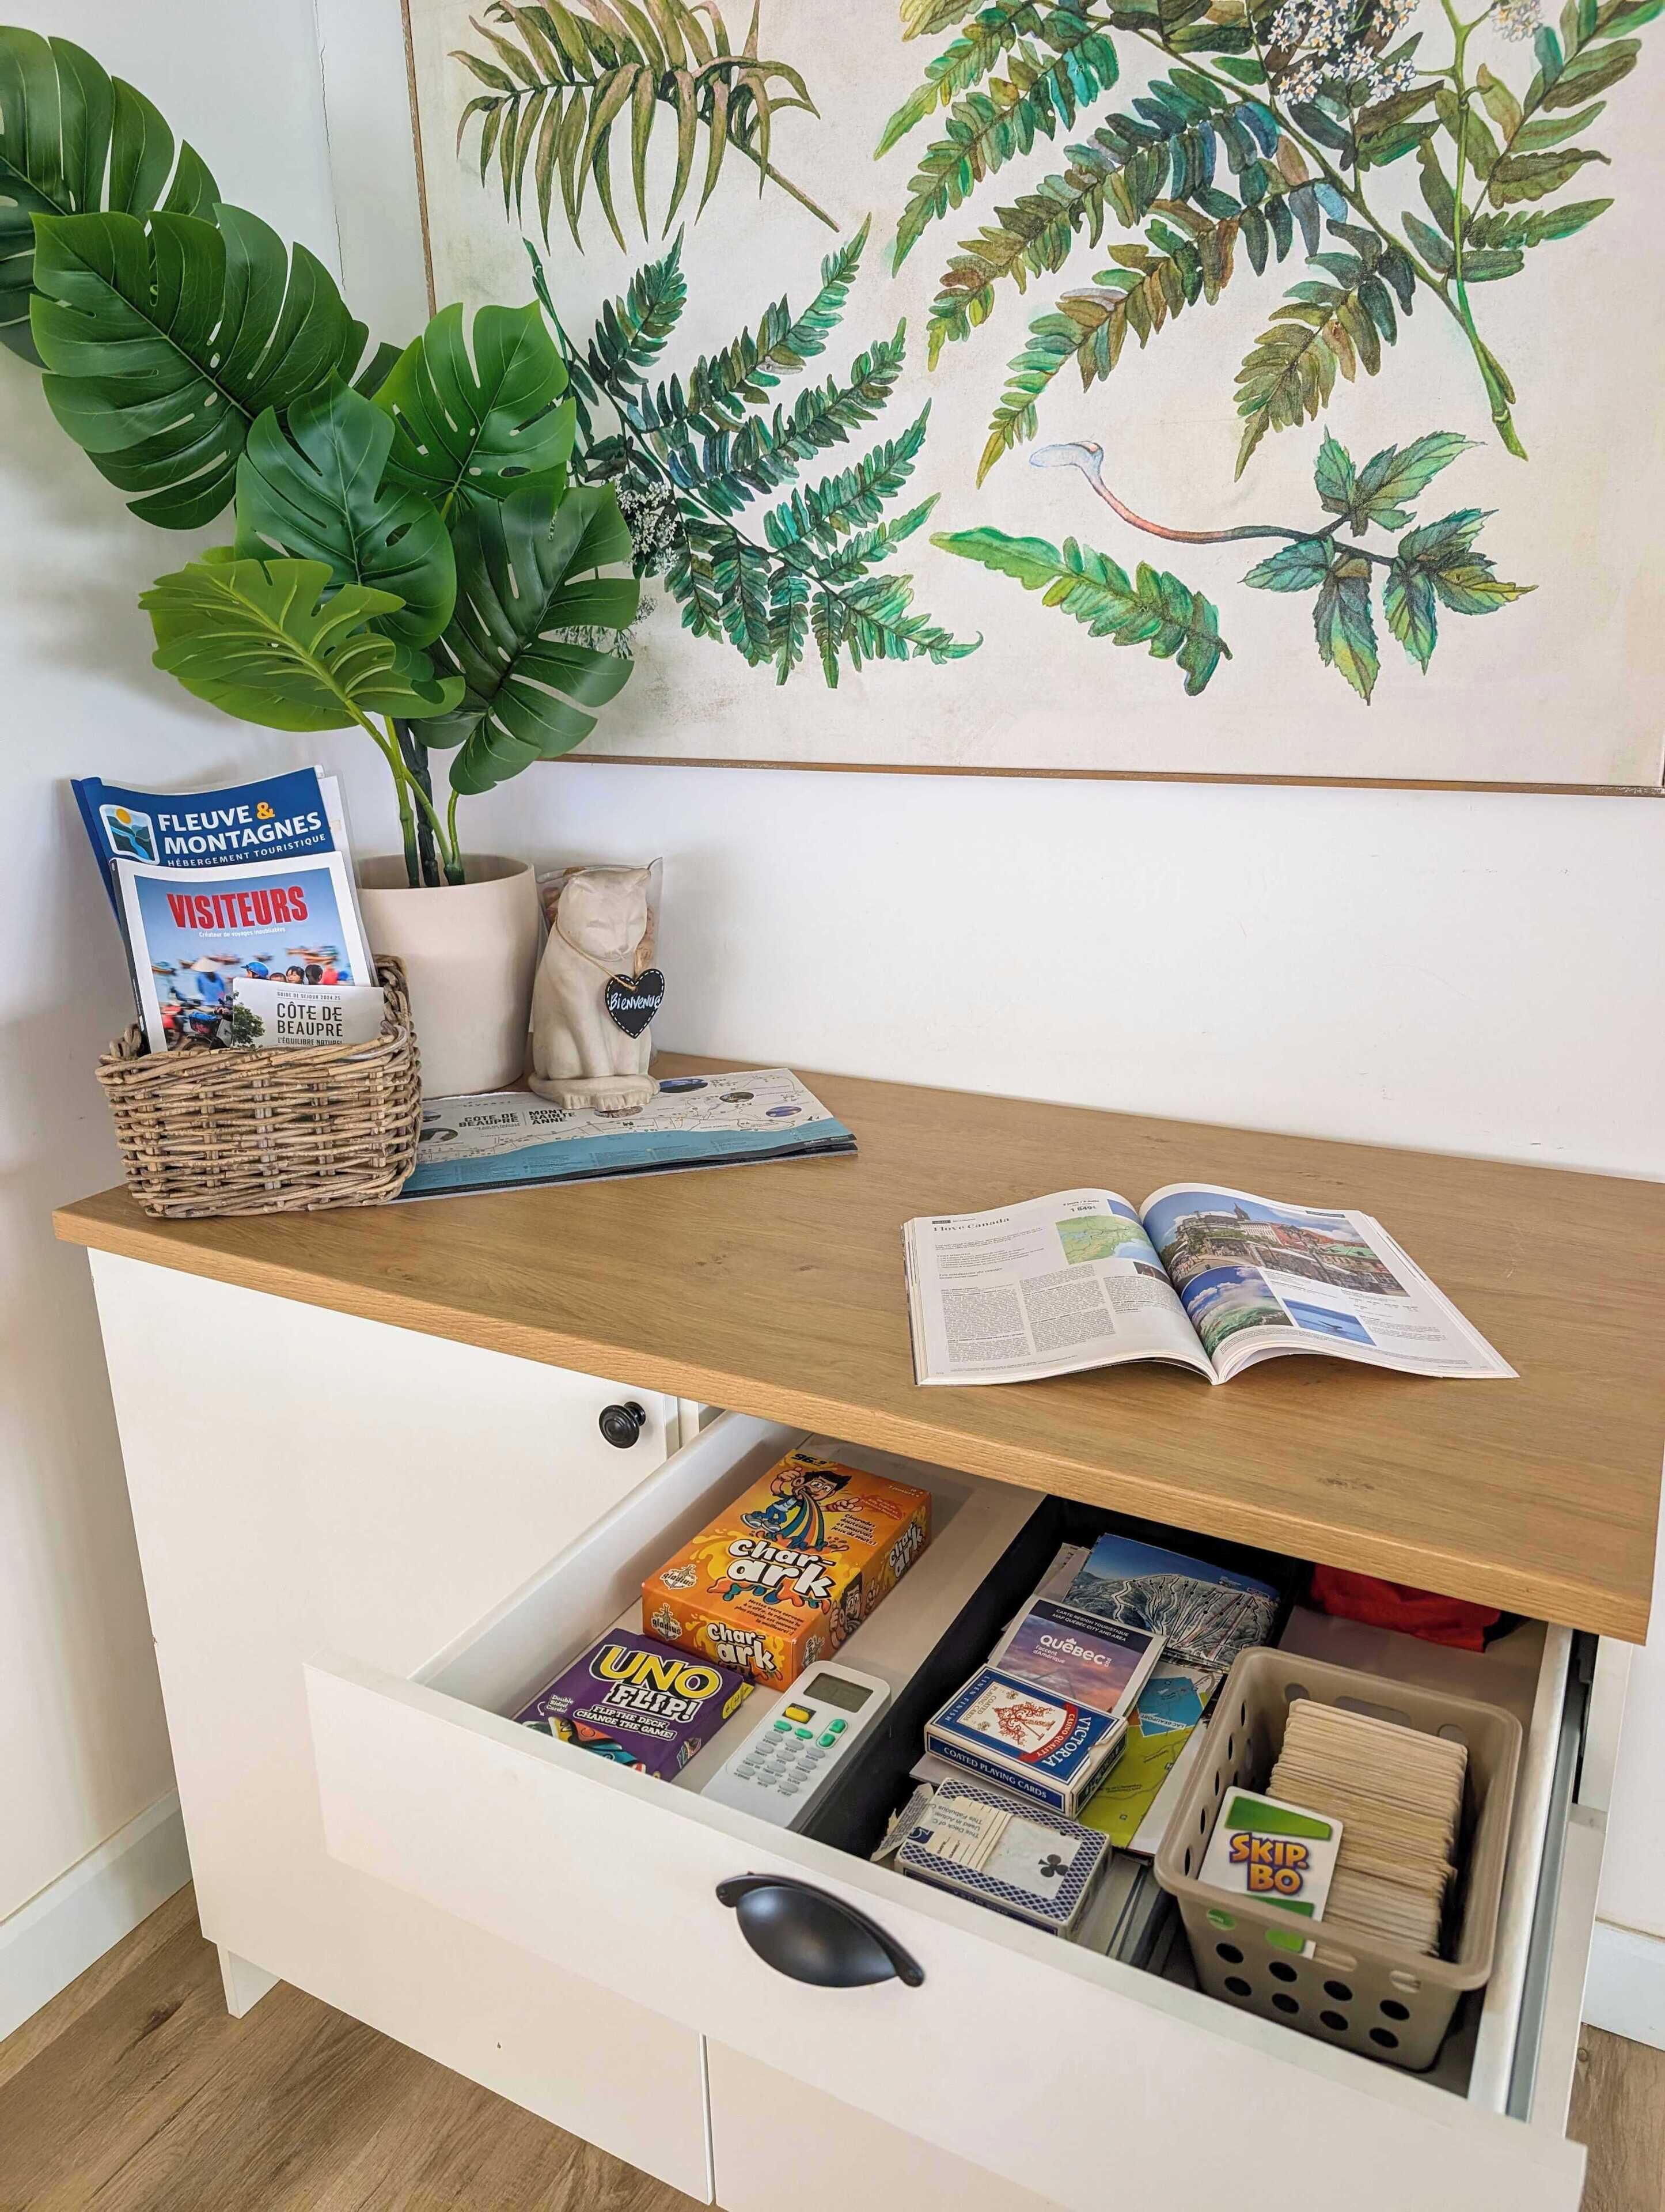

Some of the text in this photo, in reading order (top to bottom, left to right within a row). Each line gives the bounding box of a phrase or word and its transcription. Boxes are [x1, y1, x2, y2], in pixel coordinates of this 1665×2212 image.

[158, 802, 275, 831] FLEUVE &
[165, 812, 322, 855] MONTAGNES
[168, 834, 326, 867] HÉBERGEMENT TOURISTIQUE
[166, 885, 309, 930] VISITEURS
[277, 1001, 342, 1022] CÔTE DE
[278, 1037, 314, 1046] L'ÉQUILIBRE
[530, 1112, 576, 1120] SAINTE
[532, 1117, 567, 1125] ANNE
[968, 1218, 1010, 1229] Canada
[840, 1518, 873, 1532] douteuses
[845, 1514, 876, 1528] Charades
[844, 1525, 873, 1538] mauvais
[662, 1572, 694, 1586] gladius
[727, 1559, 835, 1599] ark
[749, 1599, 767, 1608] Mettez
[783, 1612, 804, 1623] cerveau
[653, 1618, 682, 1635] gladius
[1056, 1609, 1129, 1637] CARTE RÉGION TOURISTIQUE
[1098, 1628, 1112, 1637] AND
[1111, 1634, 1127, 1642] AREA
[717, 1639, 777, 1671] ark
[597, 1646, 721, 1700] UNO
[549, 1700, 568, 1708] Sided
[552, 1695, 574, 1705] Double
[610, 1684, 699, 1721] FLIP!
[945, 1675, 990, 1722] LINEN FINISH
[978, 1685, 999, 1706] PLAYING
[547, 1705, 567, 1714] Cards!
[593, 1706, 616, 1715] FLIP
[616, 1711, 637, 1721] THE
[977, 1695, 996, 1715] COATED
[577, 1711, 673, 1739] CHANGE THE GAME!
[1141, 1714, 1171, 1726] BEAUPORT
[1037, 1714, 1075, 1757] CASINO QUALITY
[1041, 1717, 1092, 1767] VICTORIA
[943, 1747, 1047, 1799] COATED PLAYING CARDS
[938, 1805, 968, 1819] Fabulous
[969, 1816, 983, 1825] This
[949, 1824, 964, 1833] Deck
[963, 1822, 980, 1831] Used
[969, 1830, 979, 1839] This
[1249, 1863, 1301, 1895] BO
